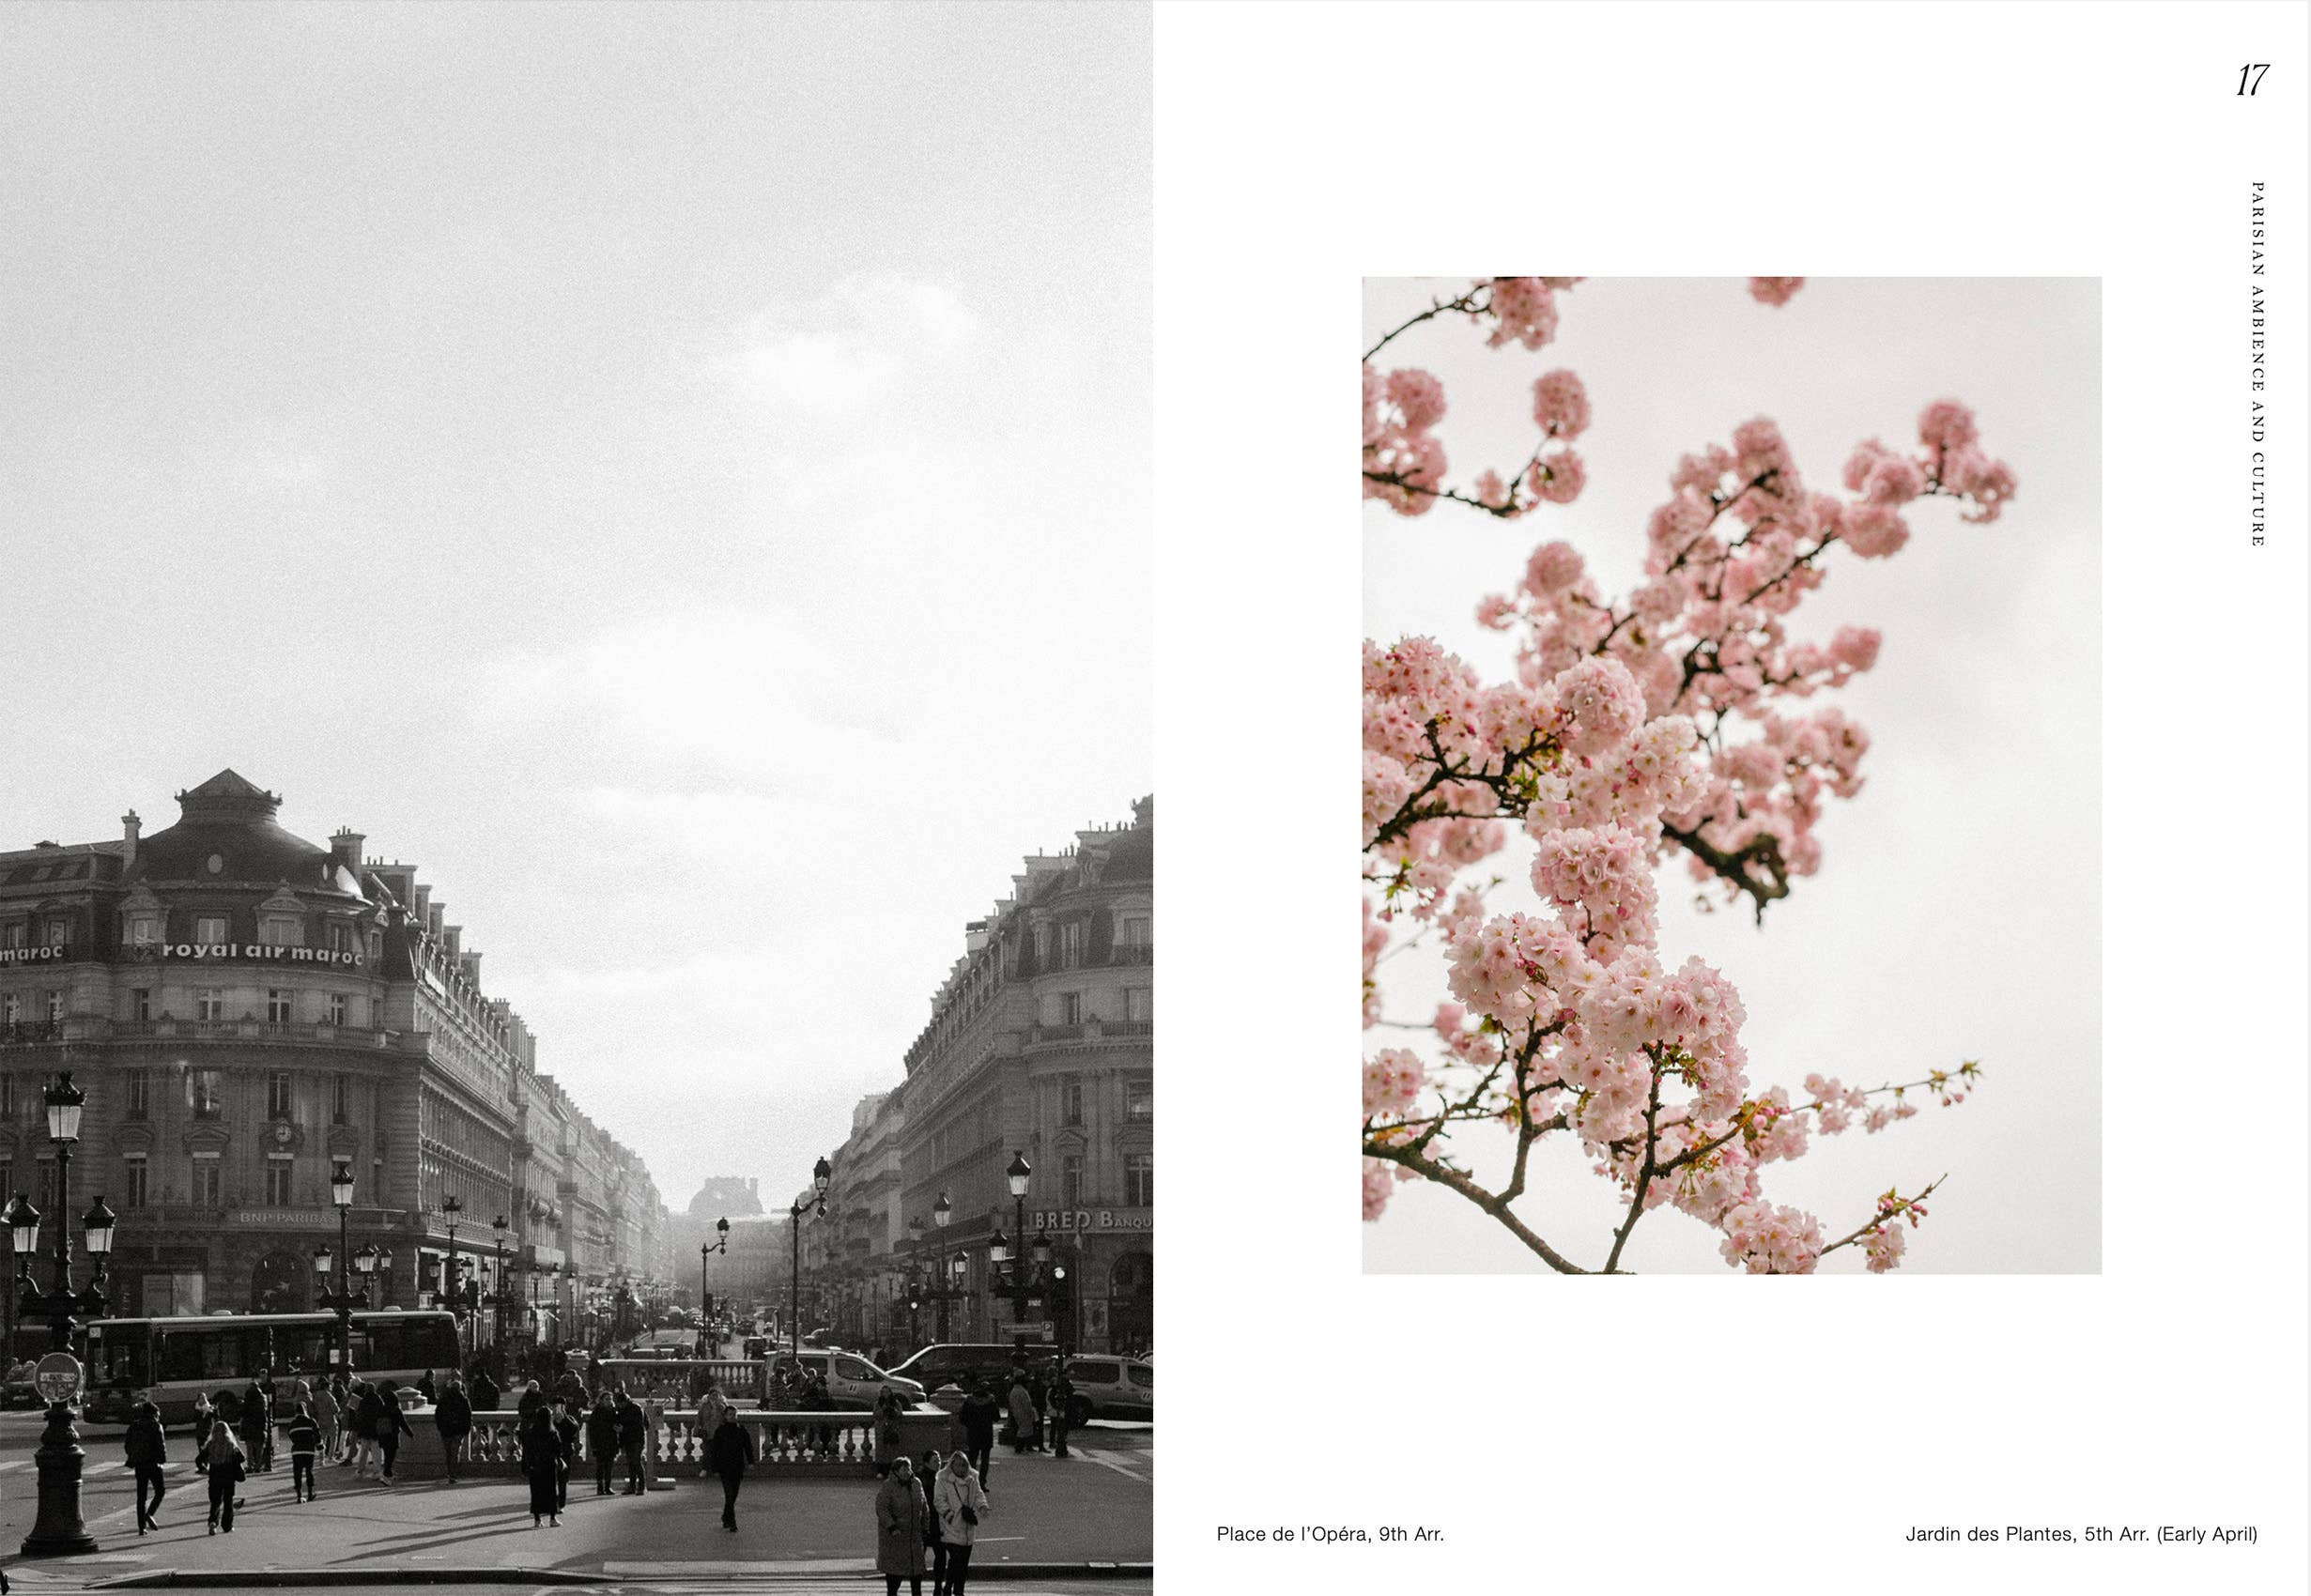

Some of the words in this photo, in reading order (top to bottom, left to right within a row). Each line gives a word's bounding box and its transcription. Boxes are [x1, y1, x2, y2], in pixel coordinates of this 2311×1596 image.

[0, 944, 64, 962] maroc
[162, 943, 238, 959] royal
[245, 944, 285, 959] air
[291, 946, 364, 966] maroc
[240, 1212, 271, 1223] BNP
[276, 1212, 335, 1224] PARIBAS
[1035, 1210, 1091, 1229] BRED
